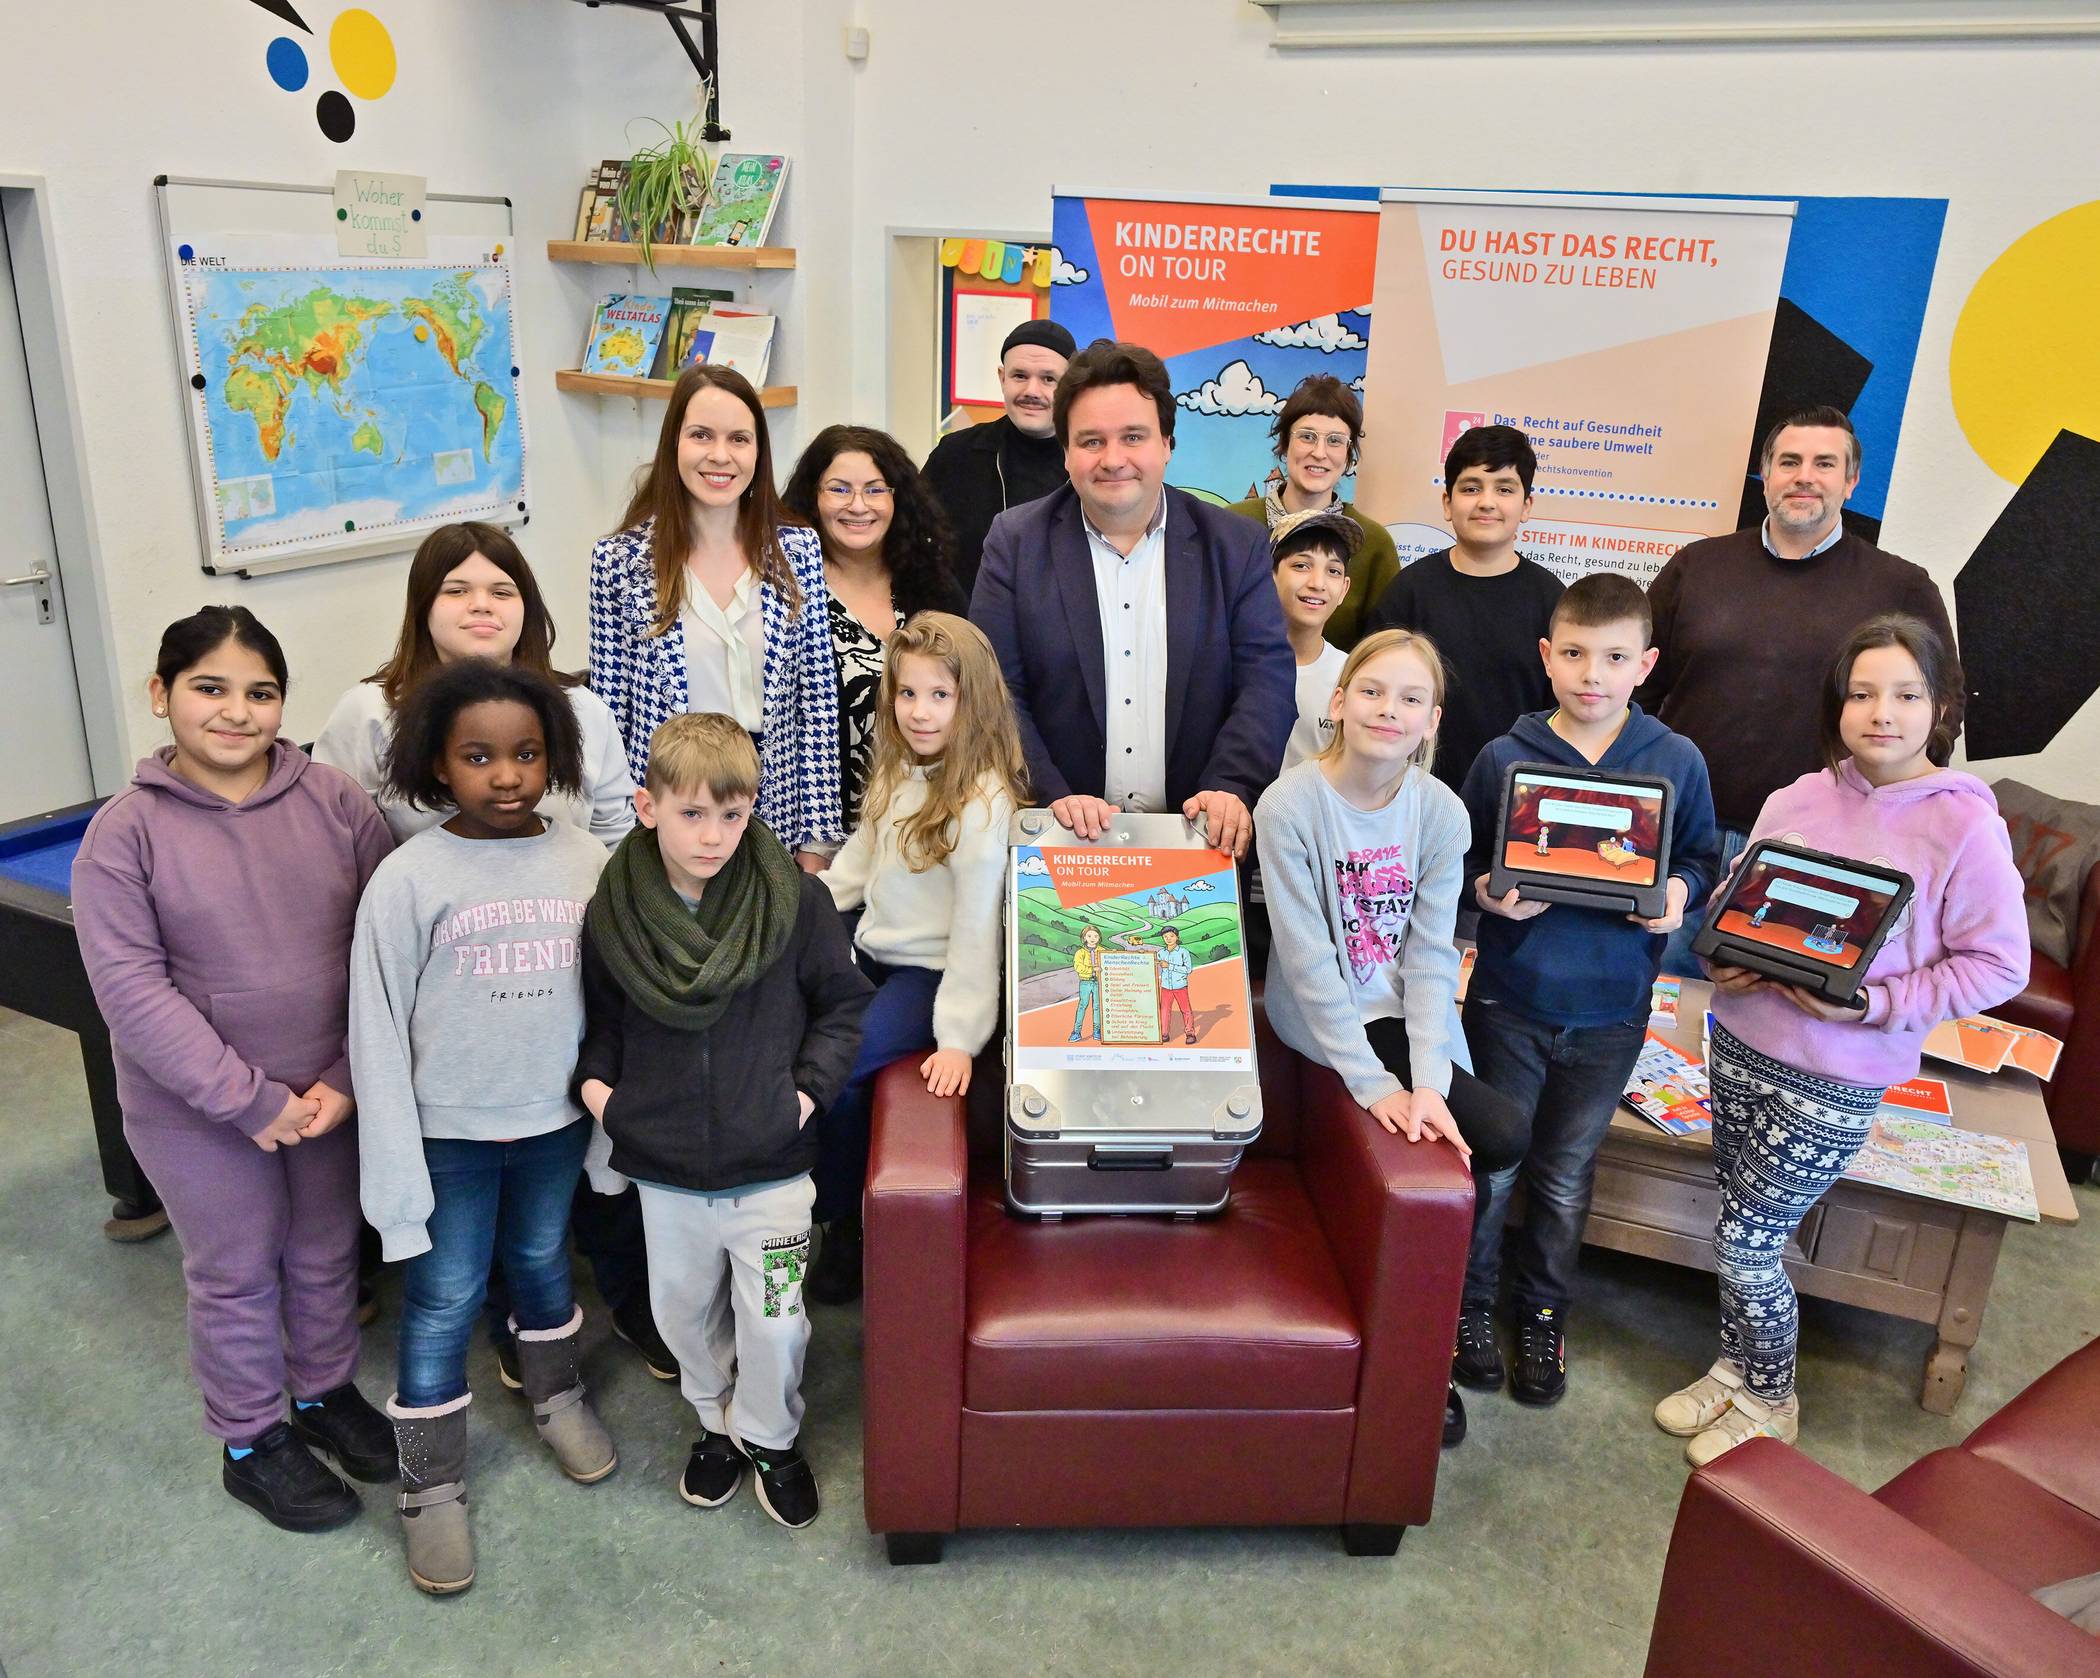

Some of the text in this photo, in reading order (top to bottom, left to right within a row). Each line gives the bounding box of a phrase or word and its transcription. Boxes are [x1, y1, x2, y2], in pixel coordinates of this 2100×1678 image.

[352, 177, 405, 206] Woher
[349, 203, 408, 233] kommst
[1115, 220, 1321, 256] KINDERRECHTE
[1440, 228, 1718, 268] DU HAST DAS RECHT,
[199, 256, 226, 266] WELT
[1120, 253, 1227, 281] ON TOUR
[1442, 259, 1658, 290] GESUND ZU LEBEN
[1129, 293, 1278, 313] Mobil zum Mitmachen
[606, 309, 662, 324] WELTATLAS
[1493, 413, 1663, 438] Das Recht auf Gesundheit
[1527, 435, 1653, 455] ine saubere Umwelt
[1536, 464, 1613, 479] echtskonvention
[1521, 530, 1567, 546] STEHT
[1570, 534, 1588, 548] IM
[1526, 550, 1546, 562] das
[1548, 552, 1581, 566] Recht,
[1584, 556, 1626, 571] gesund
[1627, 562, 1640, 571] zu
[1053, 854, 1152, 866] KINDERRECHTE
[1057, 866, 1110, 877] ON TOUR
[1062, 880, 1081, 888] Mobil
[1097, 881, 1135, 889] Mitmachen
[512, 898, 536, 924] BE
[536, 897, 587, 926] WATC
